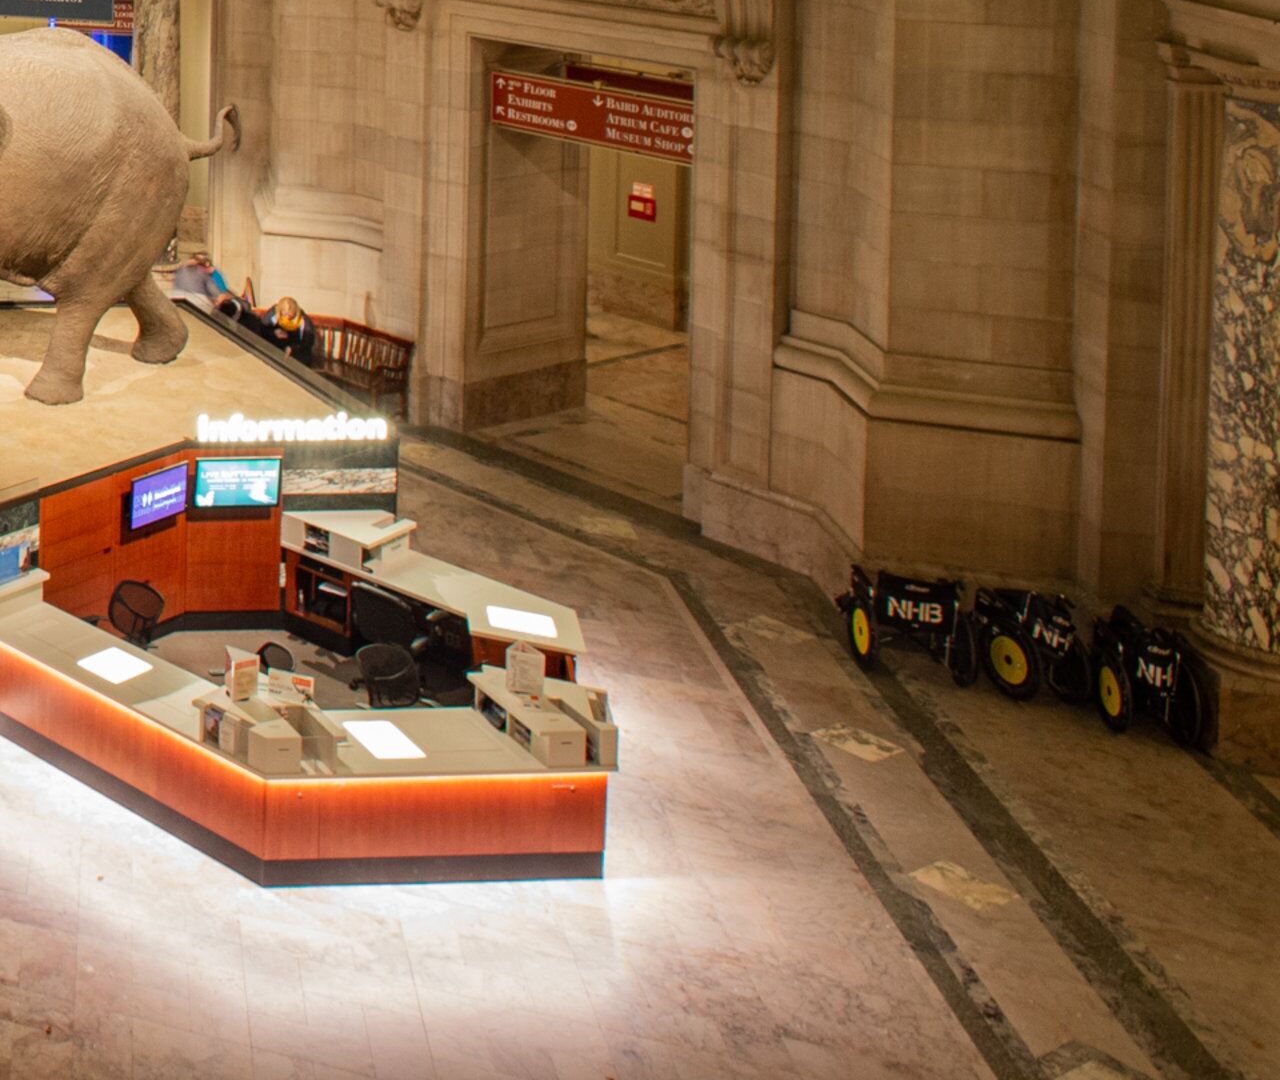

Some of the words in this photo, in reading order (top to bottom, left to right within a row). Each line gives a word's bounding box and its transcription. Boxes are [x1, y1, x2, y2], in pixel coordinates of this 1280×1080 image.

[508, 94, 553, 112] EXHIBITS
[523, 82, 557, 99] FLOOR
[507, 108, 565, 129] RESTROOMS
[605, 97, 639, 113] BAIRD
[641, 104, 694, 123] AUDITORI
[606, 113, 647, 131] ATRIUM
[605, 127, 652, 146] MUSEUM
[654, 136, 685, 153] SHOP
[197, 411, 388, 443] Information
[887, 596, 944, 624] NHB
[1032, 620, 1073, 651] NH
[1137, 656, 1174, 688] NH
